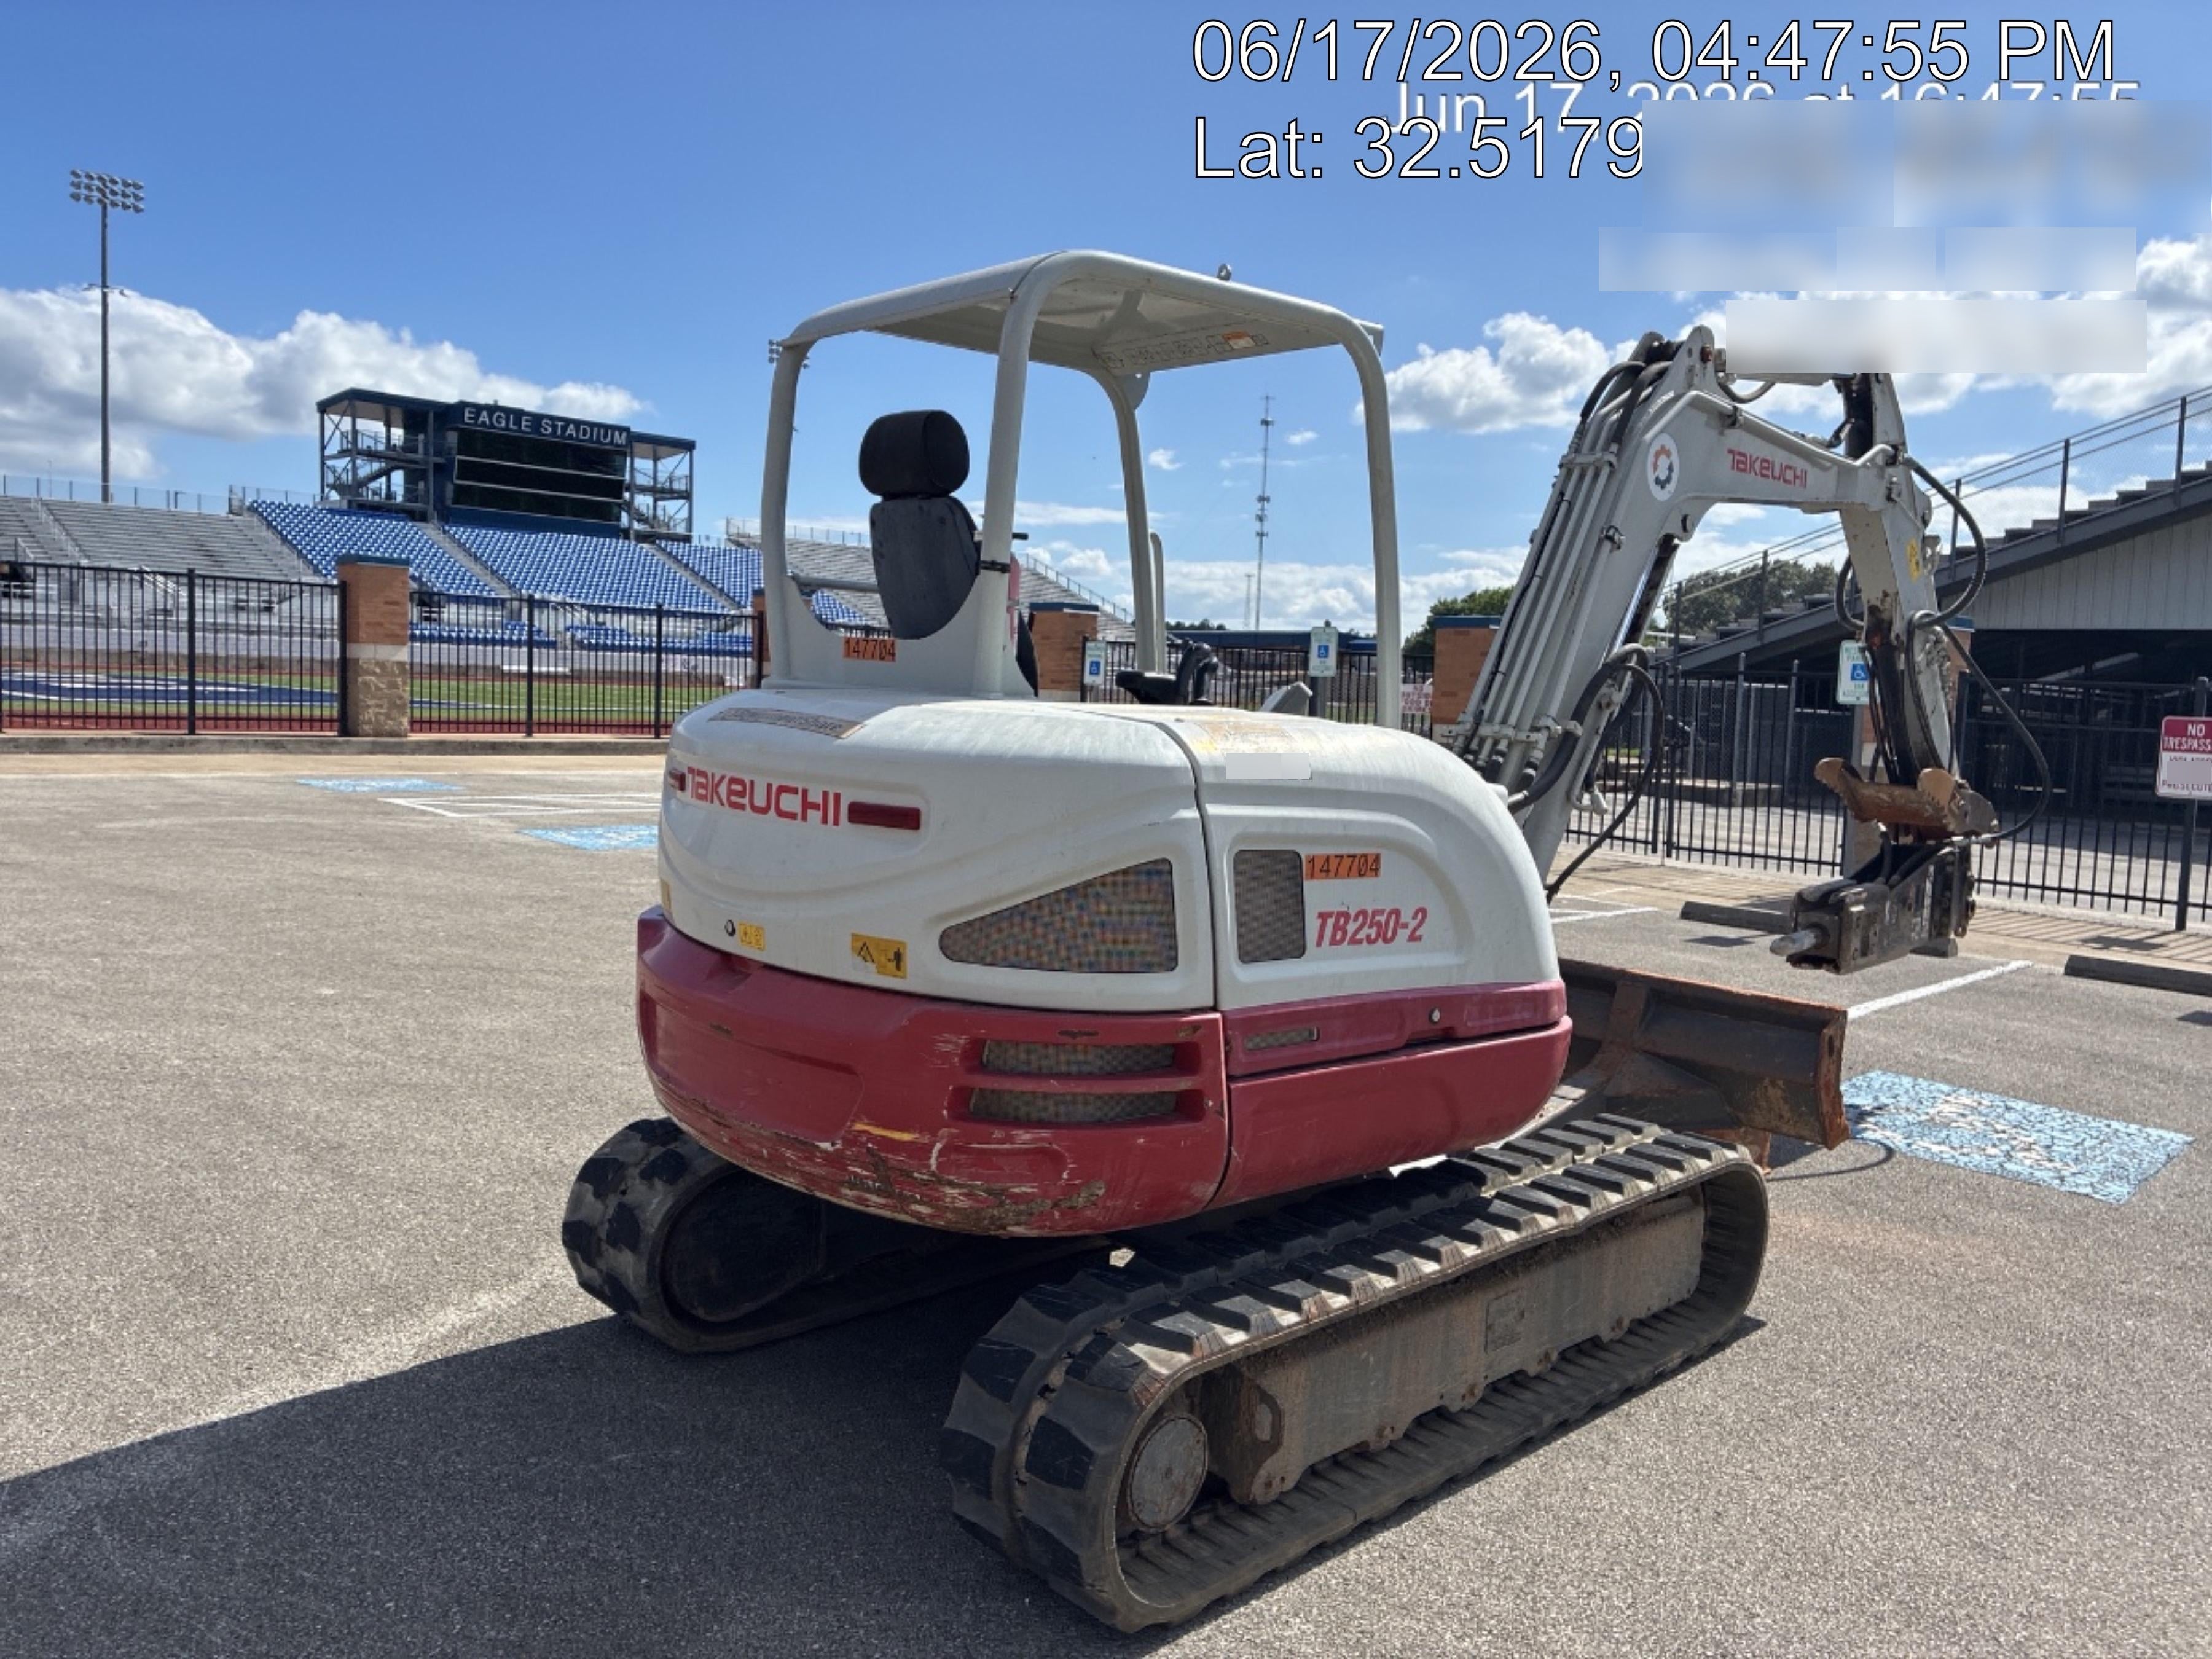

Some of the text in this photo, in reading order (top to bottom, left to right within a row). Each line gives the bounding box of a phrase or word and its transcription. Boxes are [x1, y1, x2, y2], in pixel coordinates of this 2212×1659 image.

[463, 407, 627, 445] EAGLE STADIUM
[845, 638, 896, 662] 147704
[2187, 723, 2206, 737] NO
[1308, 853, 1380, 880] 147704
[1315, 906, 1428, 947] TB250-2
